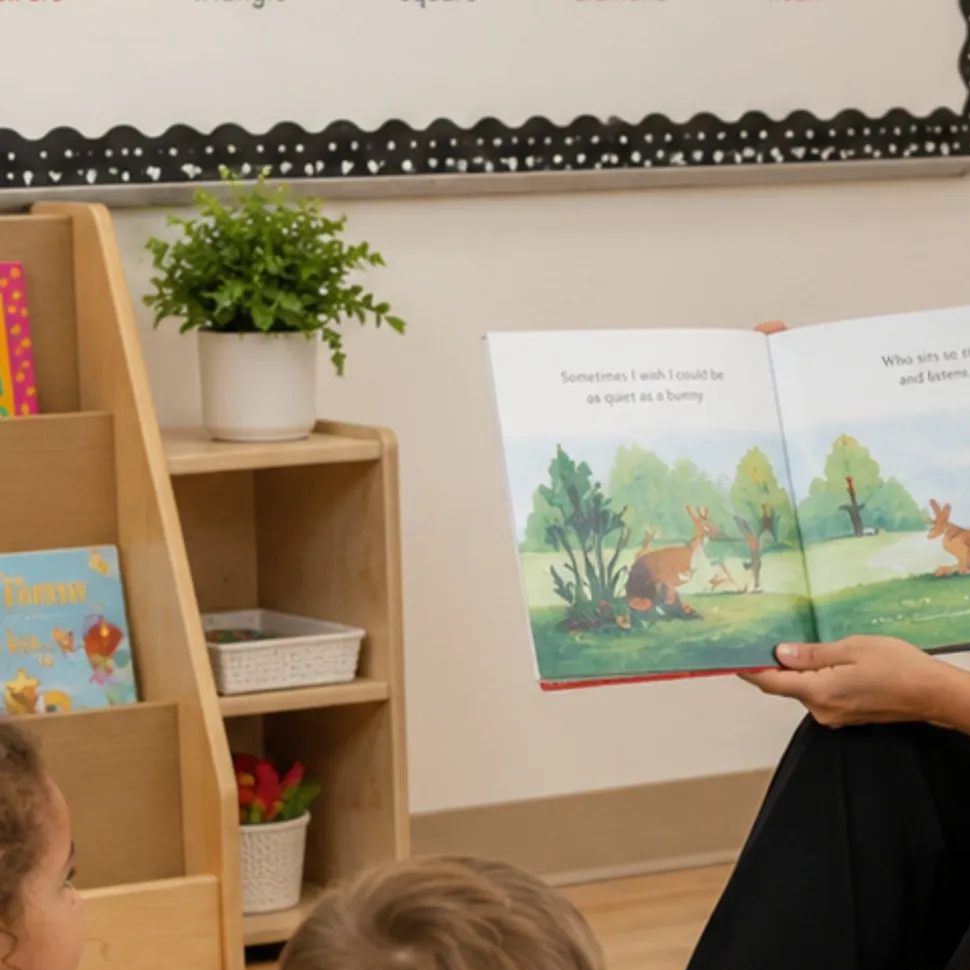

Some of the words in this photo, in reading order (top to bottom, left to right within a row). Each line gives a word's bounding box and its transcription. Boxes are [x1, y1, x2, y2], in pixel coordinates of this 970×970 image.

[880, 354, 913, 368] Who
[943, 350, 958, 361] so
[561, 369, 628, 384] Sometimes
[639, 368, 666, 382] wish
[675, 368, 708, 381] could
[710, 368, 724, 381] be
[899, 370, 924, 386] and
[587, 393, 601, 404] as
[604, 390, 636, 407] quiet
[640, 391, 653, 403] as
[656, 391, 664, 402] a
[666, 388, 704, 405] bunny
